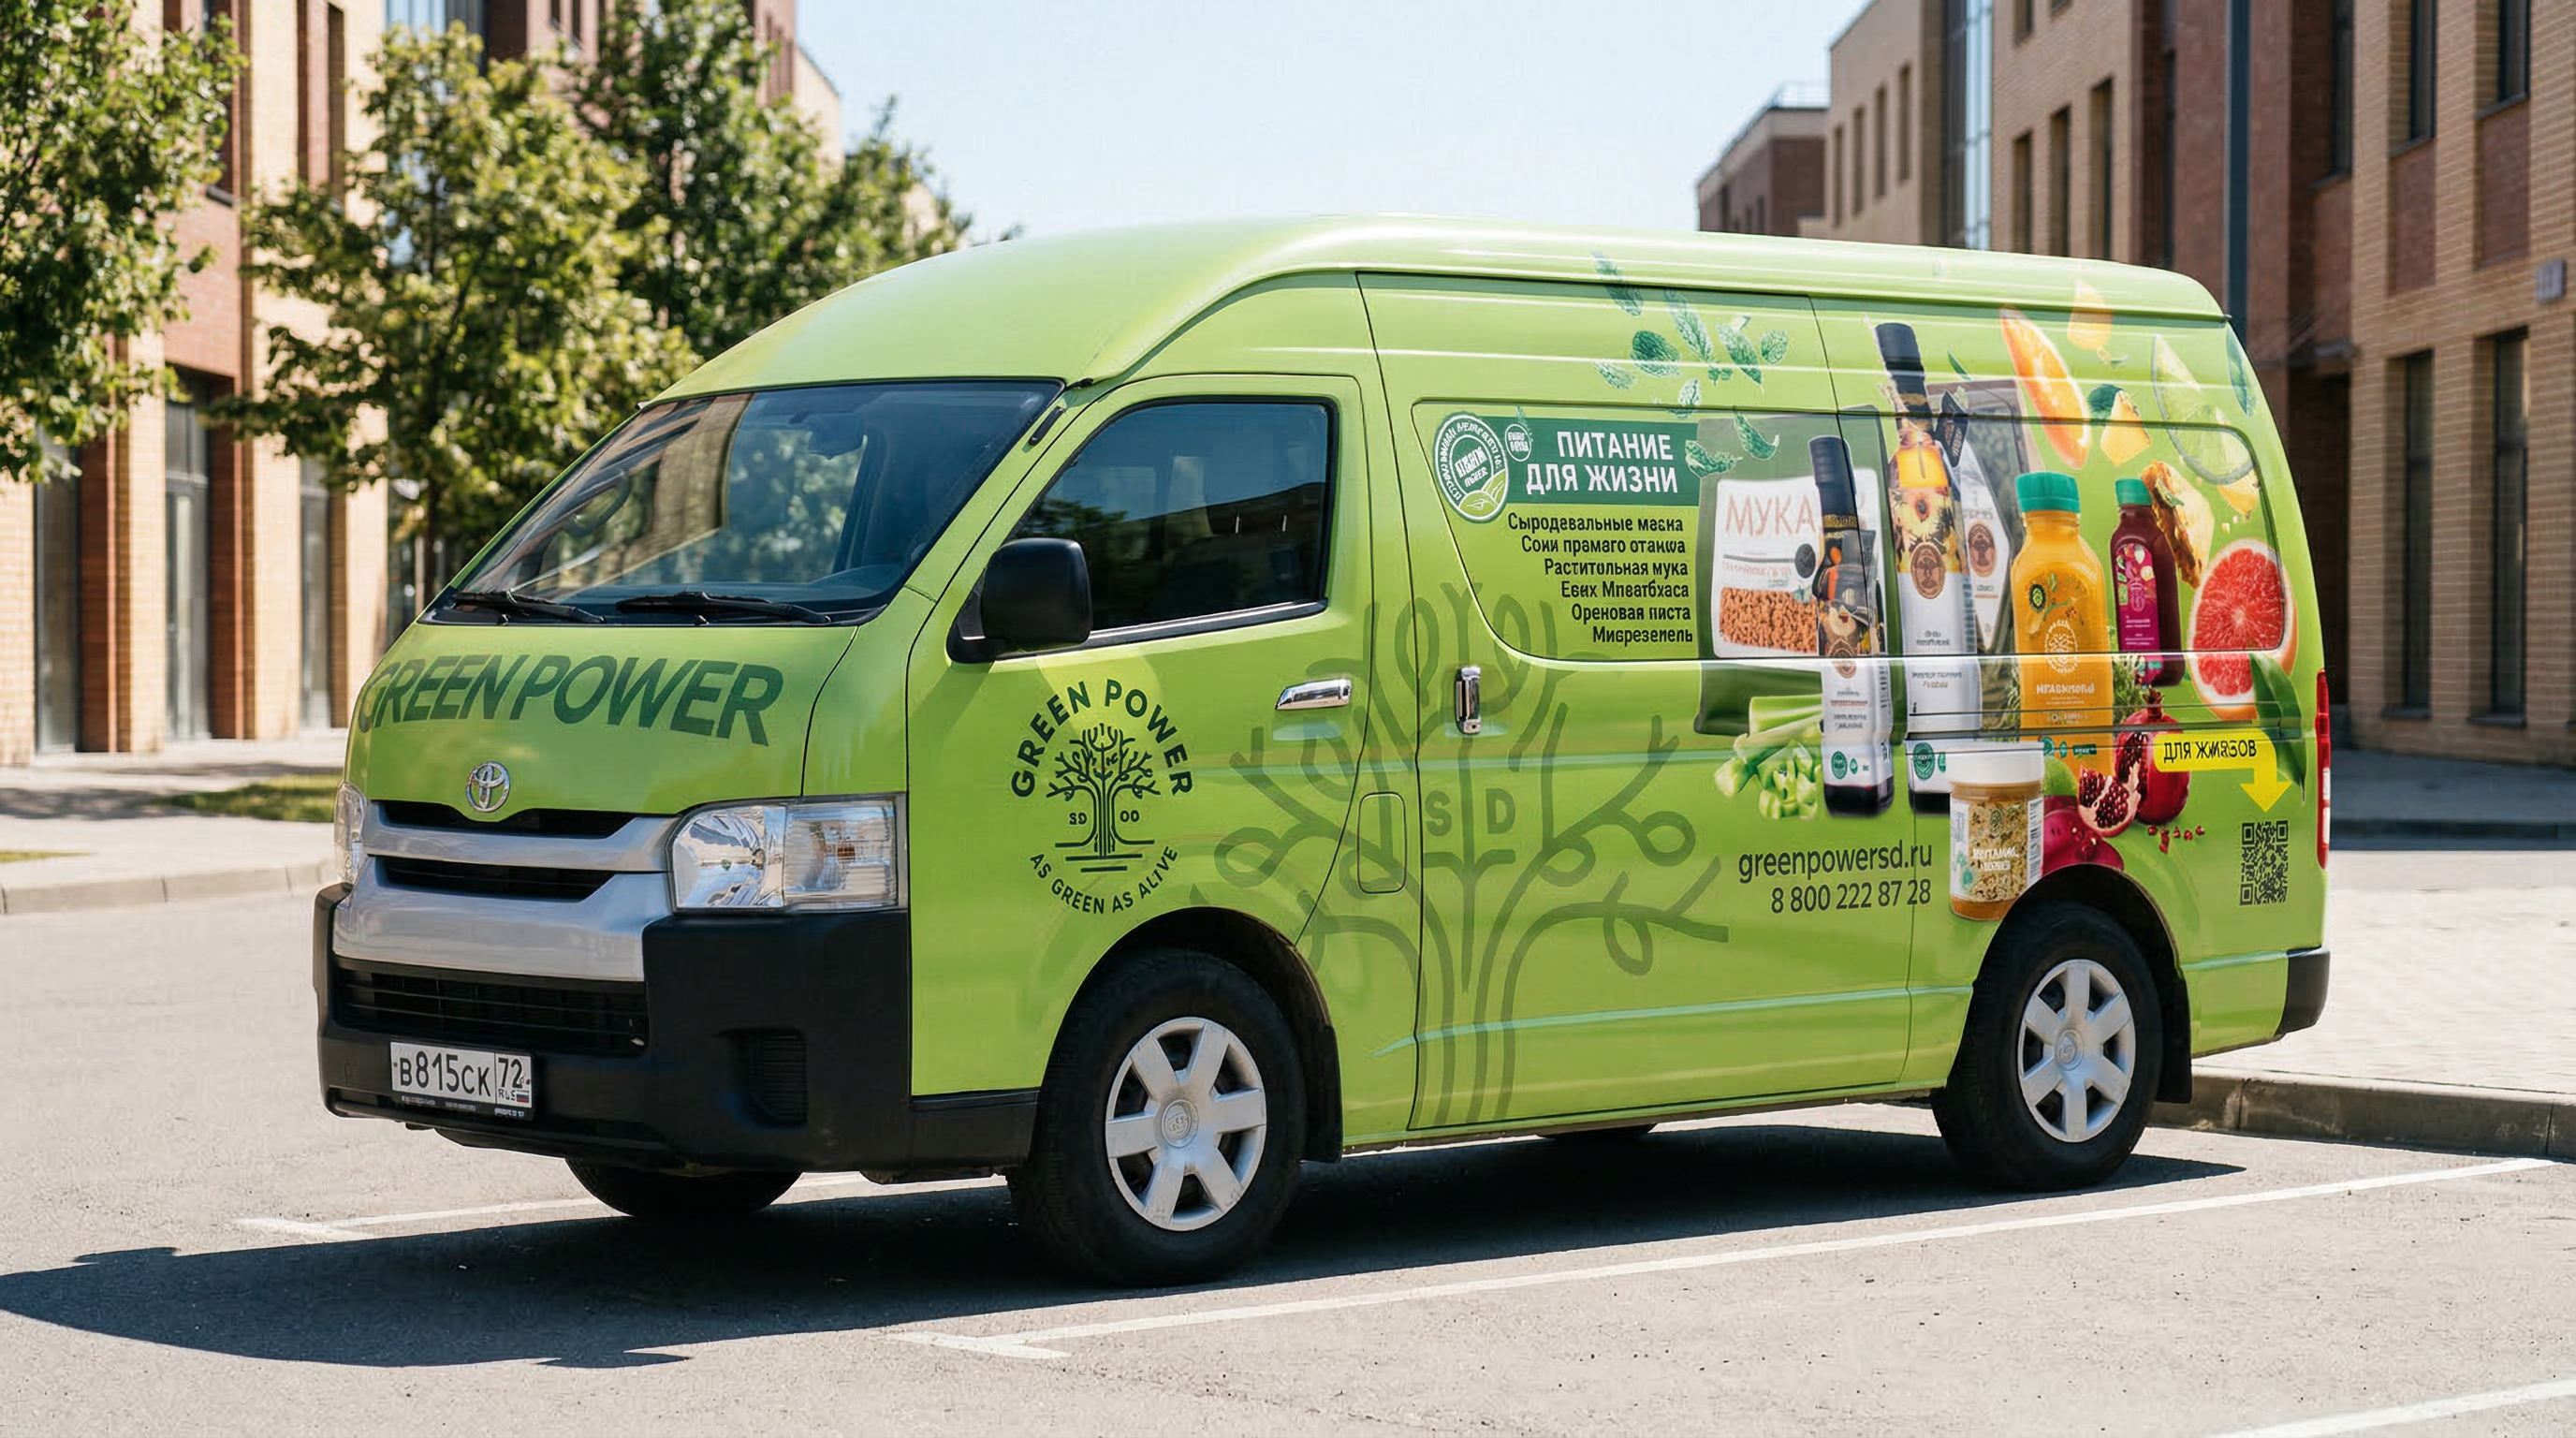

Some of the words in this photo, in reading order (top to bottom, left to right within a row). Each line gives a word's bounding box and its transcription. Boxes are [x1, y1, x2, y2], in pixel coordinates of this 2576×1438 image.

[1557, 431, 1675, 461] ПИТАНИЕ
[1526, 463, 1579, 495] ДЛЯ
[1588, 464, 1678, 493] ЖИЗНИ
[1725, 494, 1816, 537] МУКА
[1652, 561, 1689, 580] мука
[358, 653, 530, 734] GREEN
[510, 653, 783, 747] POWER
[1011, 681, 1091, 798] GREEN
[1105, 679, 1193, 795] POWER
[2163, 741, 2191, 764] ДЛЯ
[1738, 839, 1932, 884] greenpowersd.ru
[1031, 854, 1051, 879] AS
[1051, 878, 1105, 915] GREEN
[1112, 891, 1134, 914] AS
[1138, 845, 1178, 900] ALIVE
[1771, 887, 1784, 914] 8
[1790, 885, 1831, 913] 800
[1836, 881, 1872, 910] 222
[1878, 880, 1902, 907] 87
[1907, 878, 1931, 905] 28
[498, 1057, 523, 1089] 72
